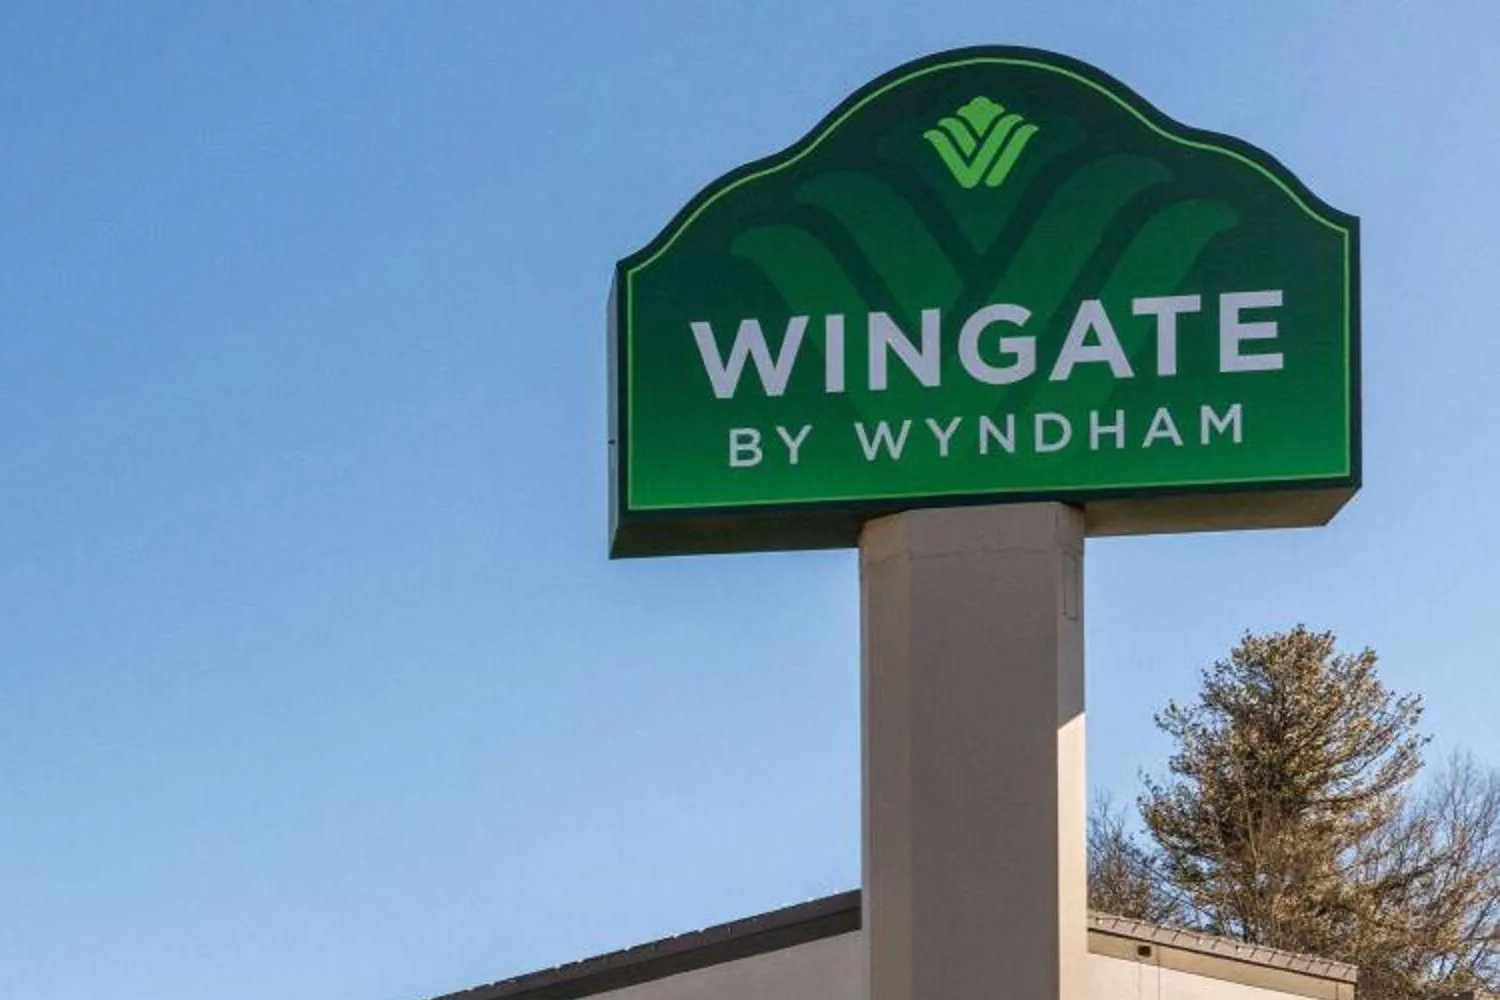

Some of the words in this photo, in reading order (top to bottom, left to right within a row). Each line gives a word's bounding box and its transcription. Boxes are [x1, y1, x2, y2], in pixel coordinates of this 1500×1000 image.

[690, 289, 1285, 399] WINGATE
[728, 425, 812, 467] BY
[855, 403, 1243, 461] WYNDHAM
